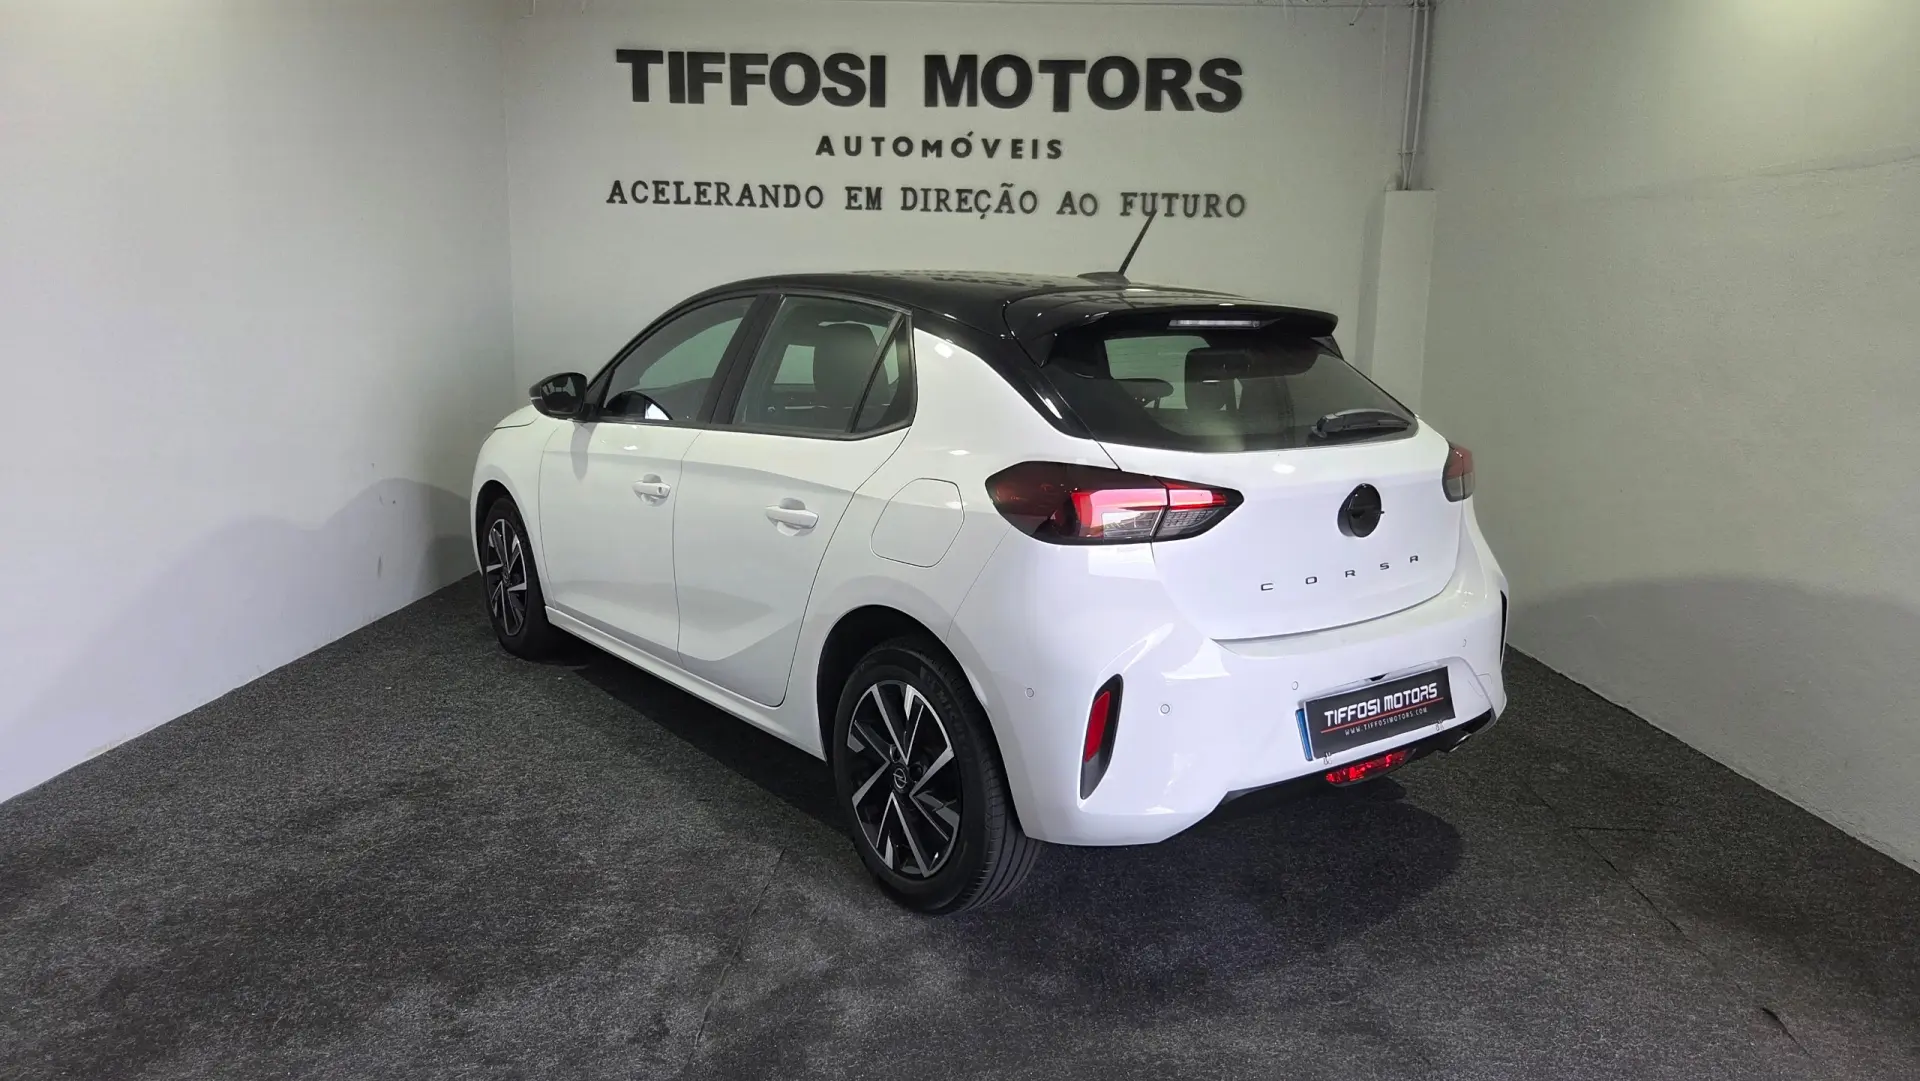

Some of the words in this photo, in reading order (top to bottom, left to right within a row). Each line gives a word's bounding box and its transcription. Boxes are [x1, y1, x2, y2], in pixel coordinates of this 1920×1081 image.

[615, 48, 886, 108] TIFFOSI
[924, 53, 1243, 112] MOTORS
[815, 131, 1063, 159] AUTOMÓVEIS
[606, 180, 825, 209] ACELERANDO
[844, 186, 883, 211] EM
[900, 183, 1038, 219] DIREÇÃO
[1056, 190, 1099, 216] AO
[1120, 191, 1246, 218] FUTURO
[1260, 555, 1419, 591] CORSA
[1323, 698, 1382, 727] TIFFOSI
[1384, 682, 1438, 712] MOTORS
